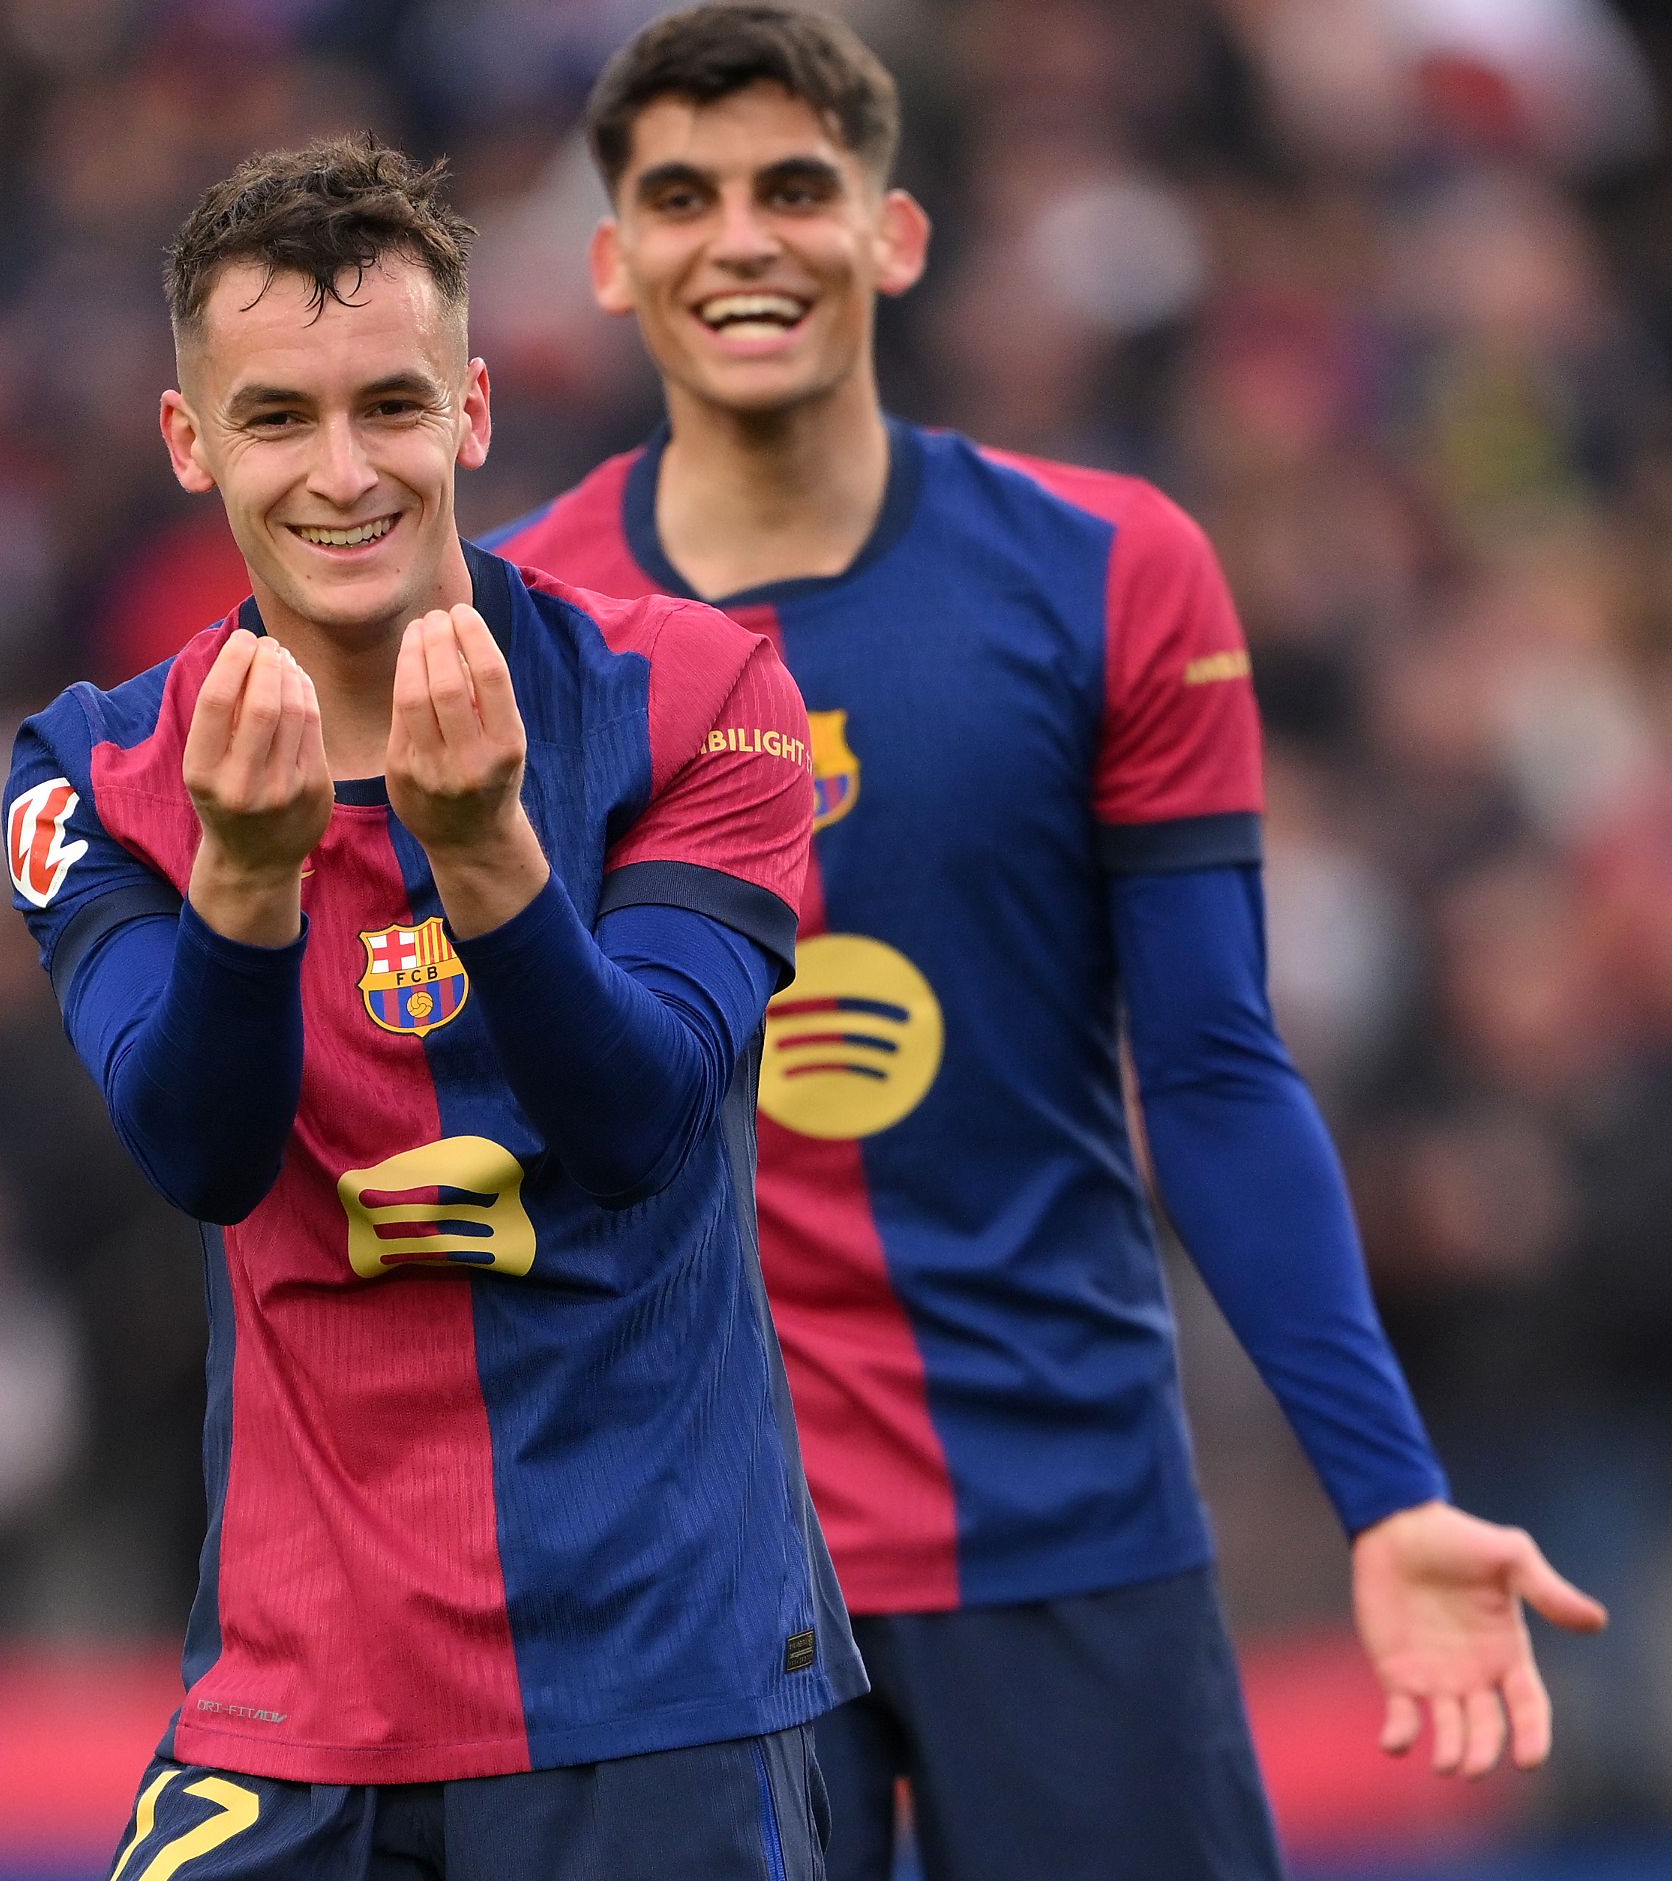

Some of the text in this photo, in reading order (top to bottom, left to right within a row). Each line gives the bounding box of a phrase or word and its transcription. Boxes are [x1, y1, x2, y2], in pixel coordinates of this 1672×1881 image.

[700, 728, 805, 767] BILIGHT
[396, 966, 438, 986] FCB
[110, 1769, 260, 1881] 17
